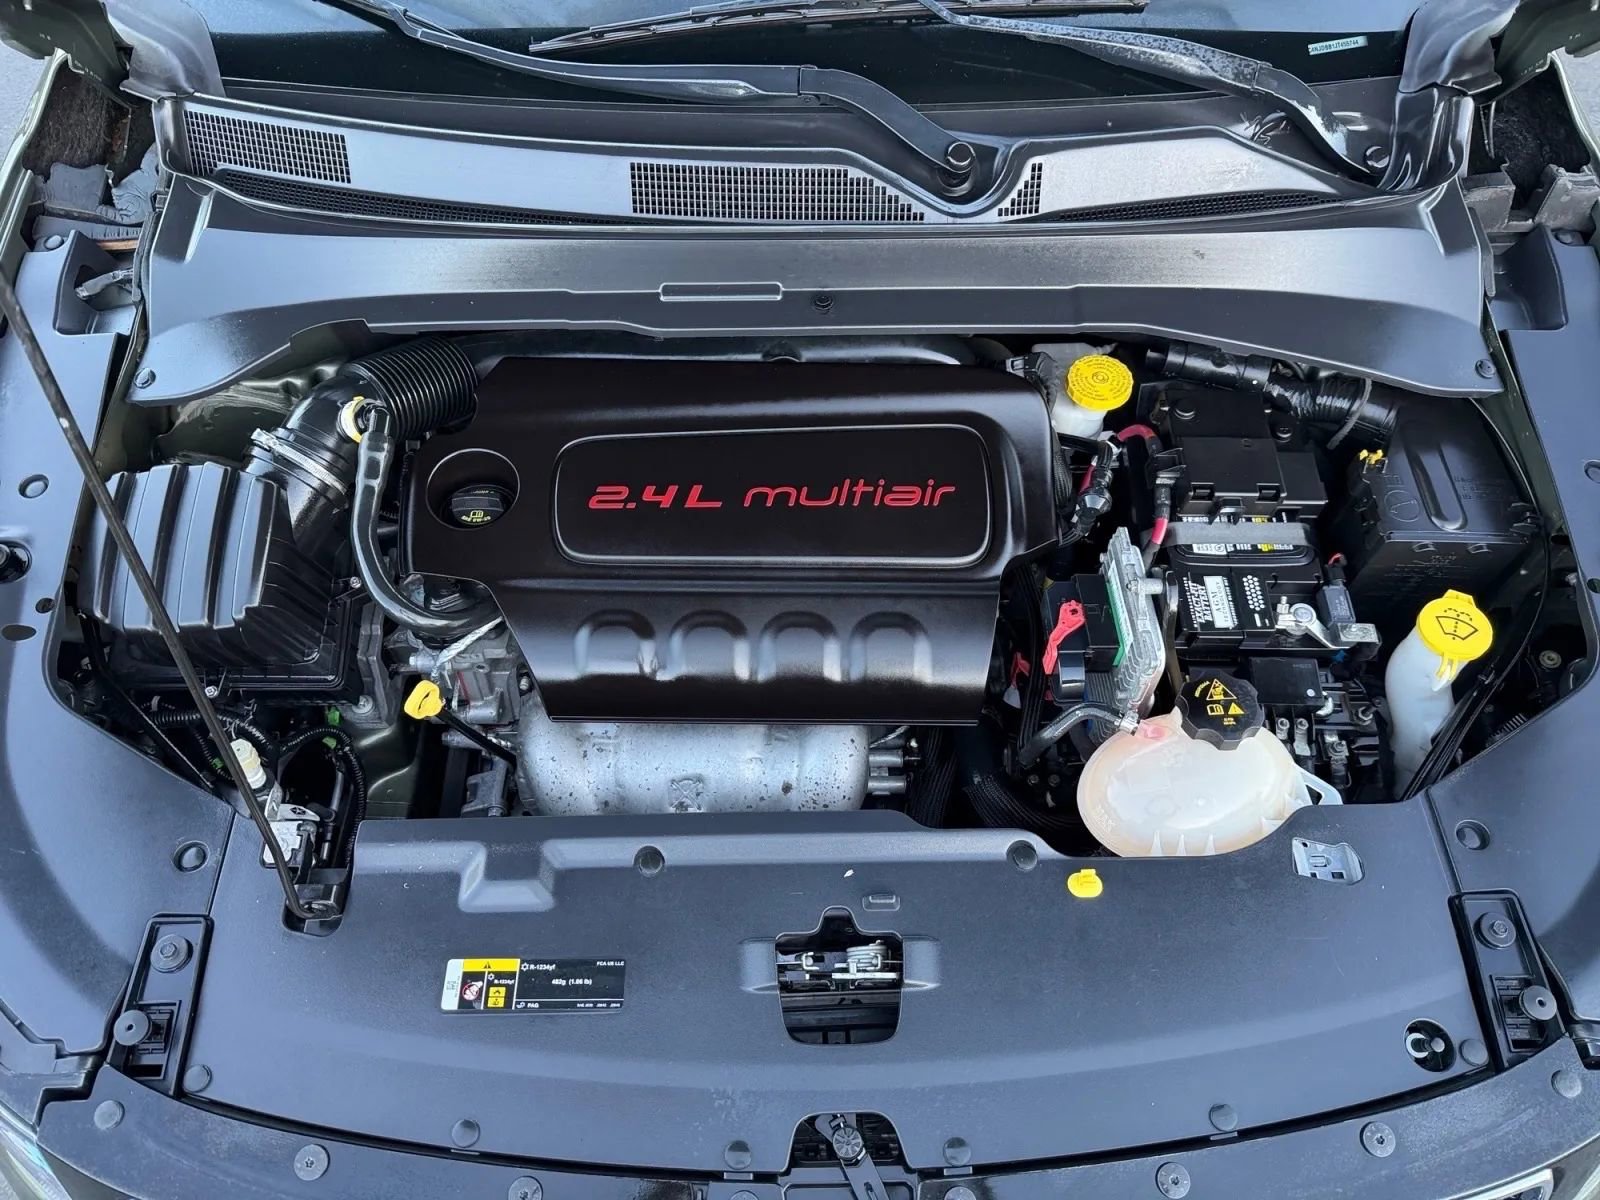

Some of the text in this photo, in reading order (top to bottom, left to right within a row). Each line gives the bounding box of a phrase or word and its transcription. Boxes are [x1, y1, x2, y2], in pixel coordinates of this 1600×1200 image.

[743, 478, 956, 507] multiair
[1188, 581, 1206, 623] EXACT-FIT
[1195, 583, 1213, 621] BATTERY
[1211, 590, 1222, 614] AGM
